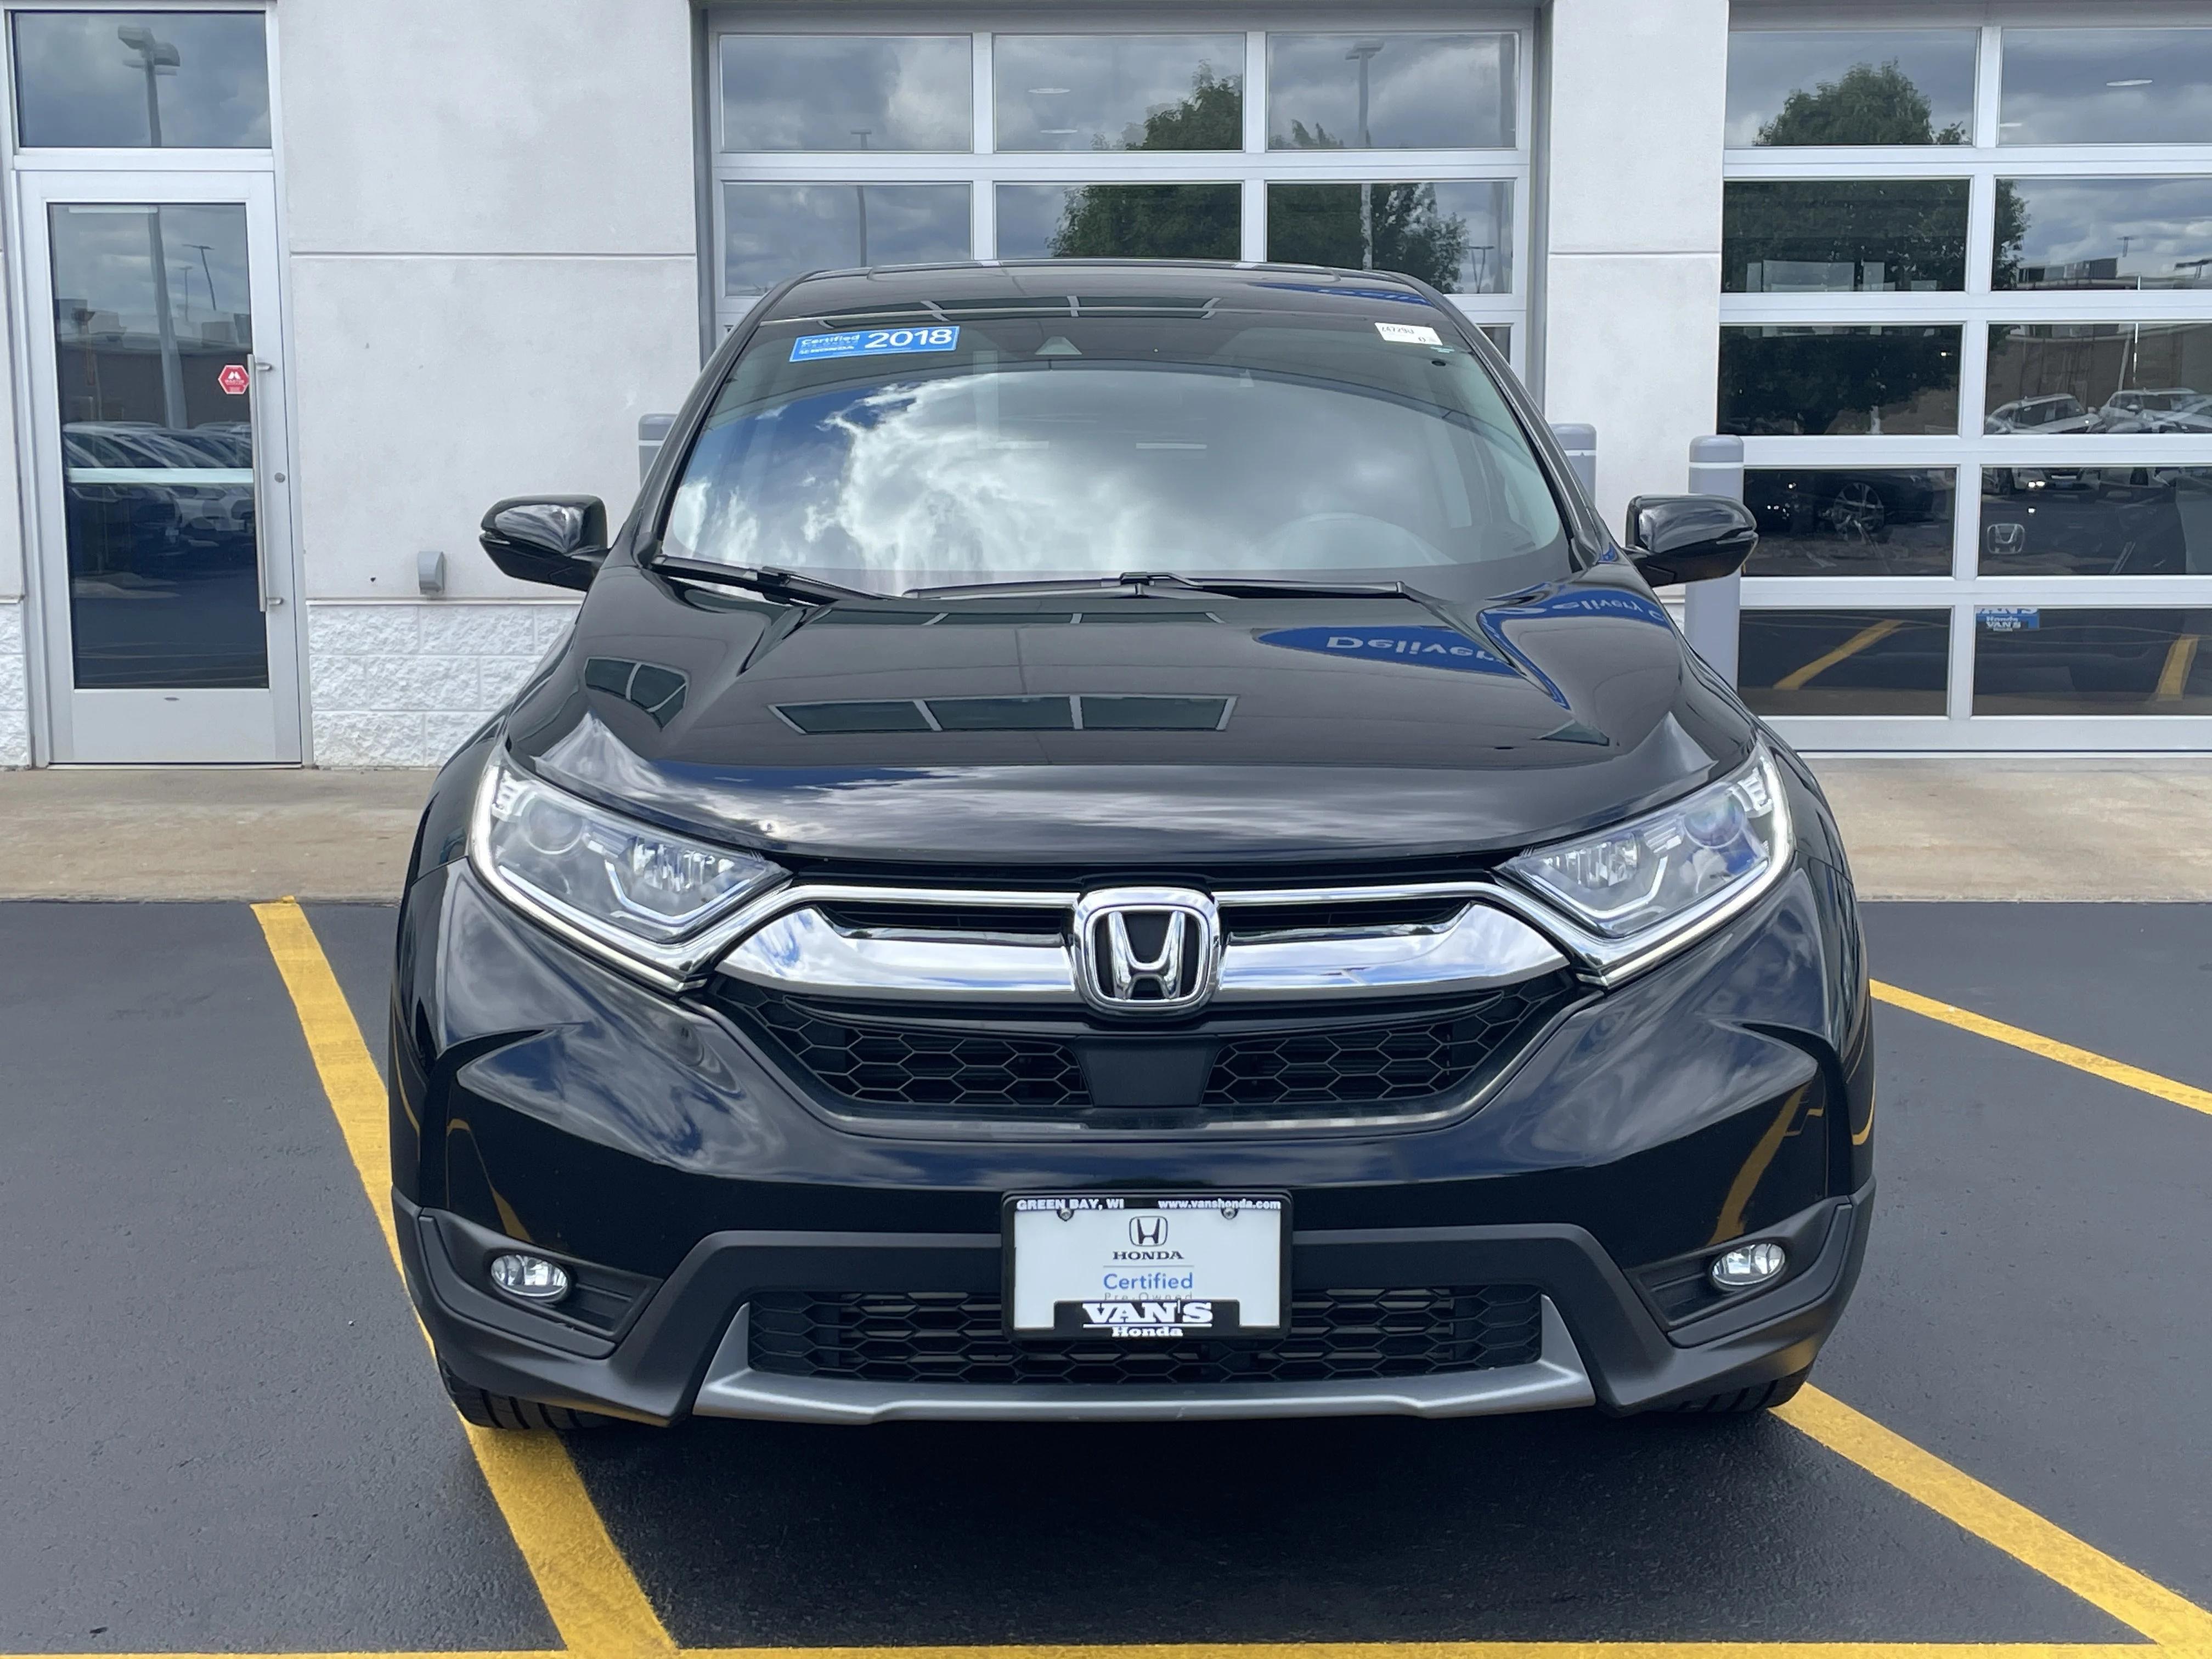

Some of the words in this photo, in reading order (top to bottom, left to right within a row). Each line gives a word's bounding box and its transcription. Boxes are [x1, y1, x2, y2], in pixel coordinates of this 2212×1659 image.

[801, 334, 860, 346] Certified
[864, 329, 953, 349] 2018
[1017, 1199, 1065, 1210] GREEN
[1069, 1199, 1103, 1210] BAY,
[1106, 1199, 1124, 1209] WI
[1158, 1198, 1281, 1209] www.vanshonda.com
[1113, 1251, 1184, 1260] HONDA
[1104, 1272, 1193, 1289] Certified
[1082, 1300, 1213, 1323] VAN'S
[1112, 1326, 1183, 1337] Honda
